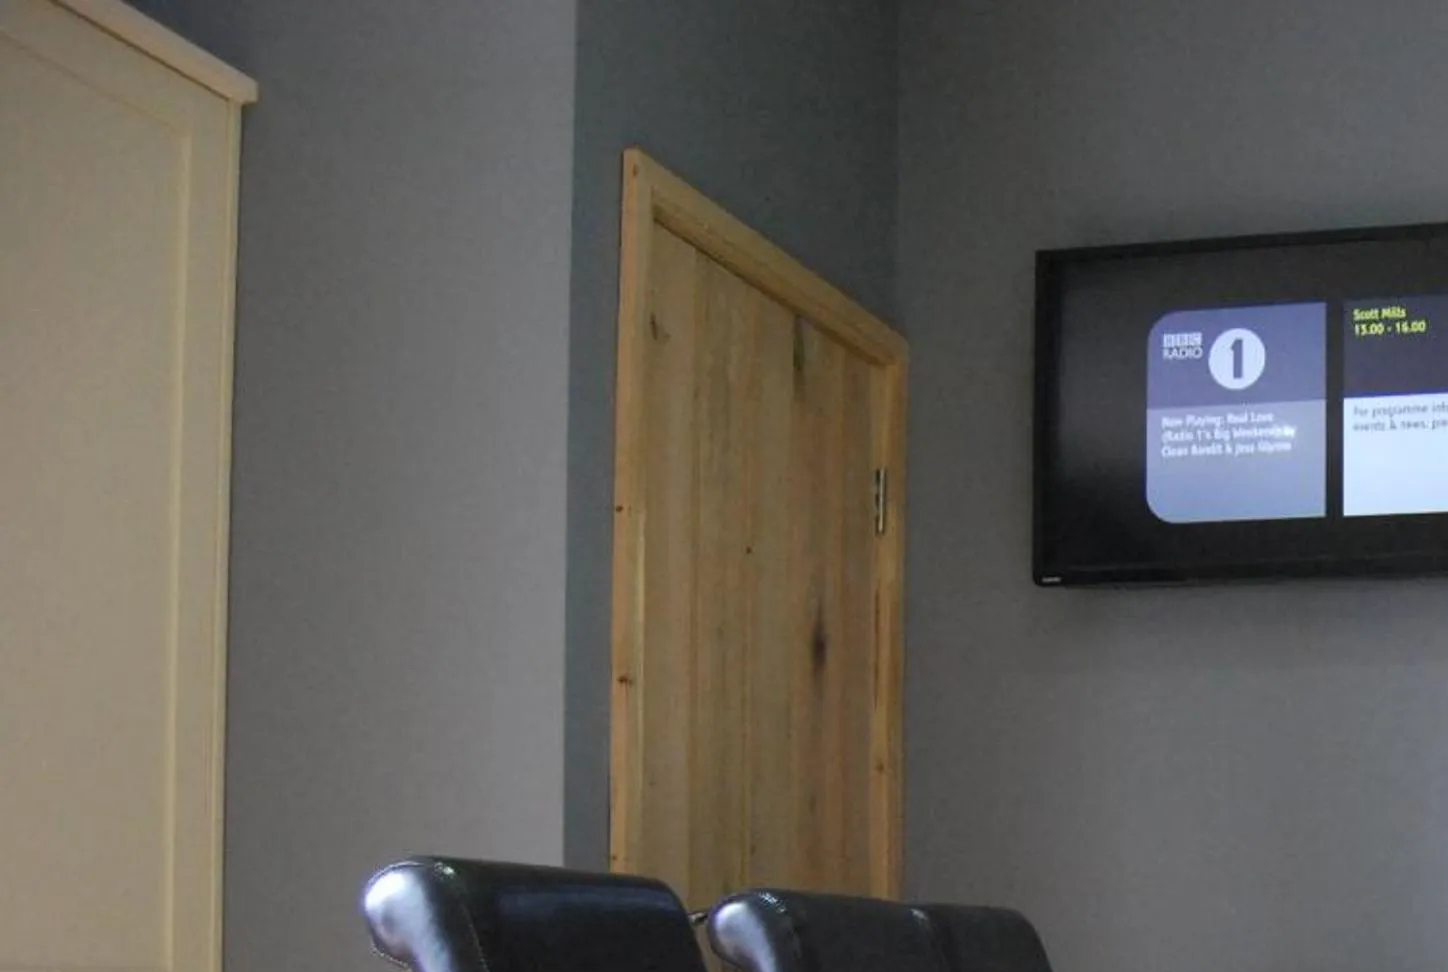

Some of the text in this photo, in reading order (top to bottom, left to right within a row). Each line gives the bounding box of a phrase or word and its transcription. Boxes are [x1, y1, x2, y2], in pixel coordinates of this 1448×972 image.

[1353, 306, 1406, 321] Scott Mills
[1163, 347, 1203, 360] RADIO
[1230, 338, 1244, 379] 1
